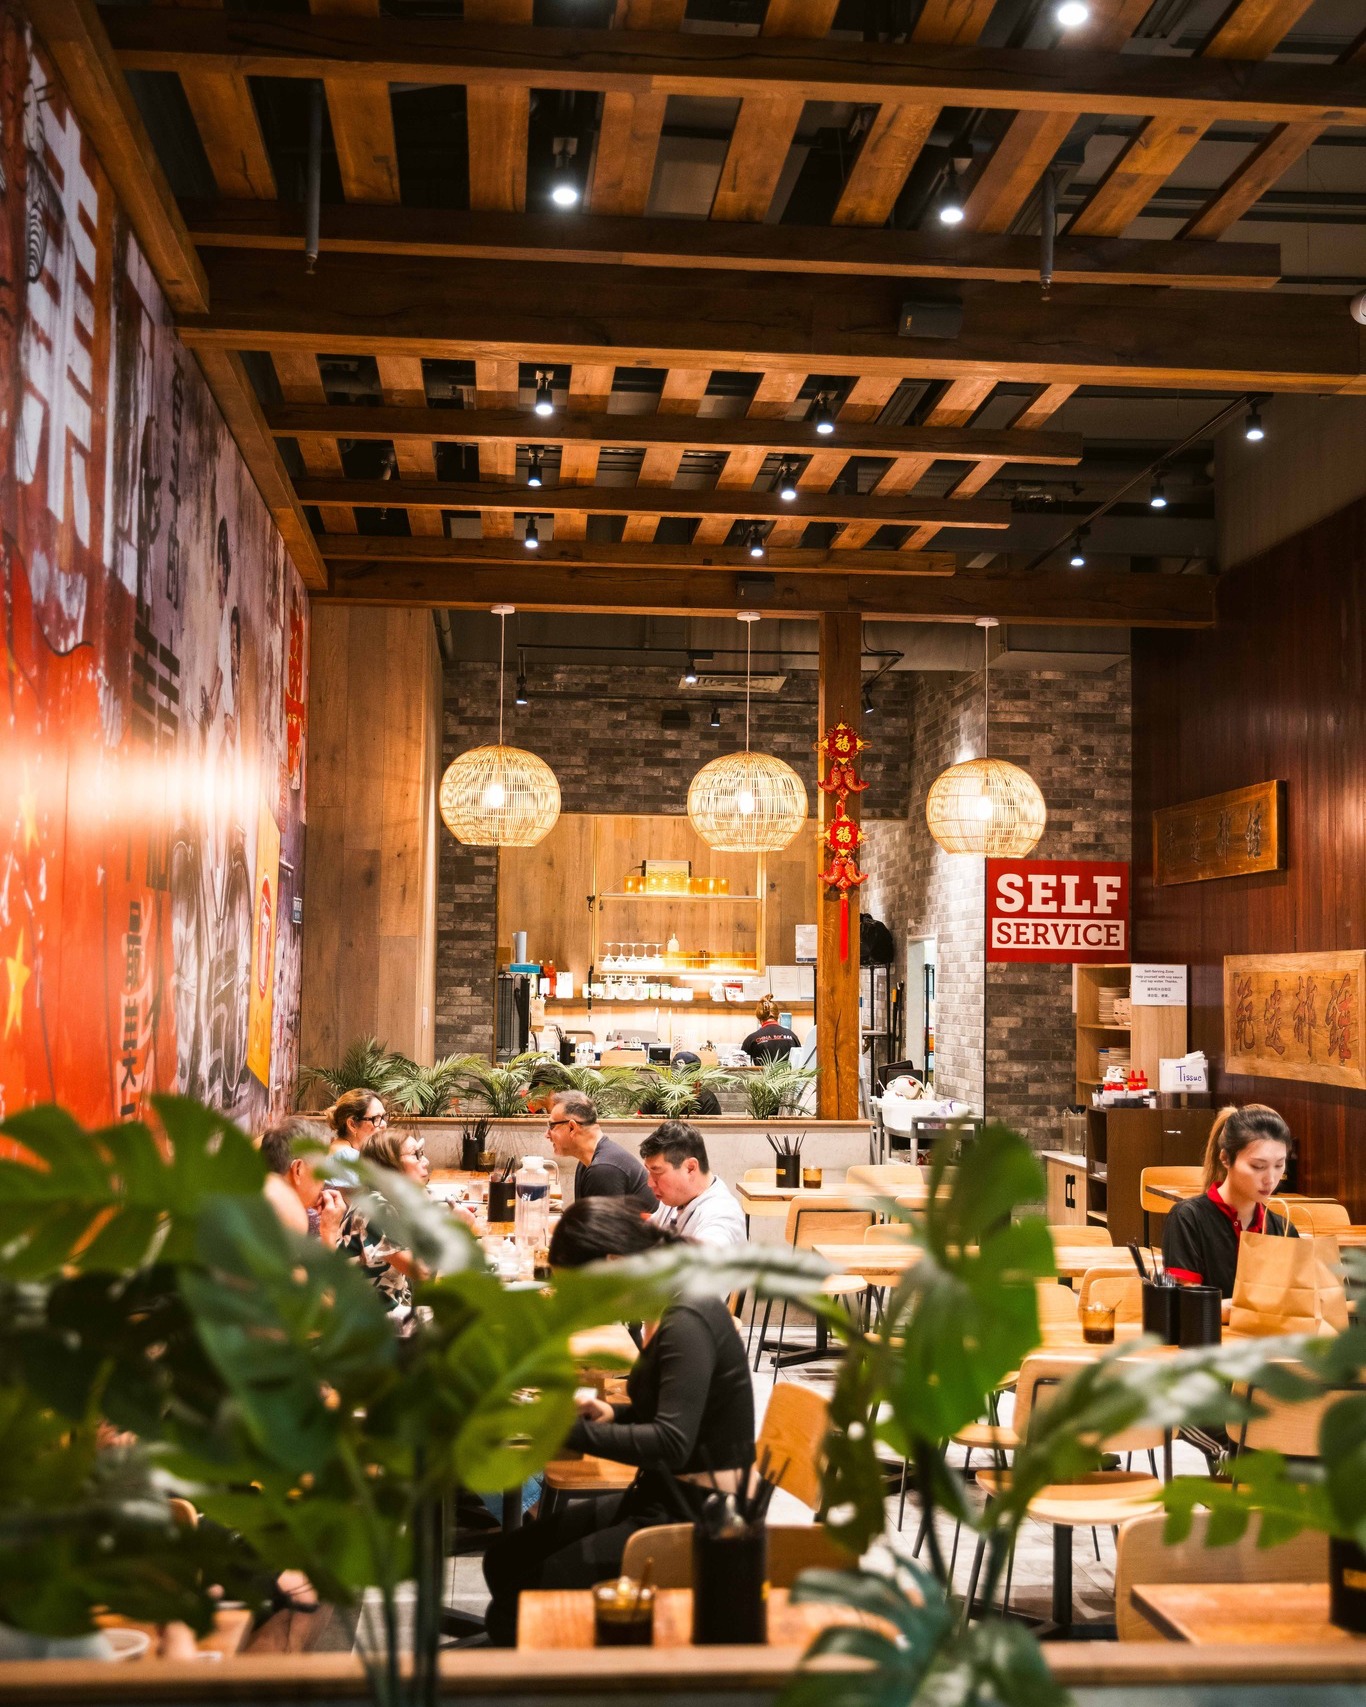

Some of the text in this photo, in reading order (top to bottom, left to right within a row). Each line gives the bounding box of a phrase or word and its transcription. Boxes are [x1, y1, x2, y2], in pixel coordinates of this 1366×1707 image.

[835, 734, 850, 752] 福
[836, 826, 851, 843] 福
[996, 873, 1121, 914] SELF
[996, 922, 1120, 946] SERVICE
[1175, 1065, 1202, 1082] Tissue
